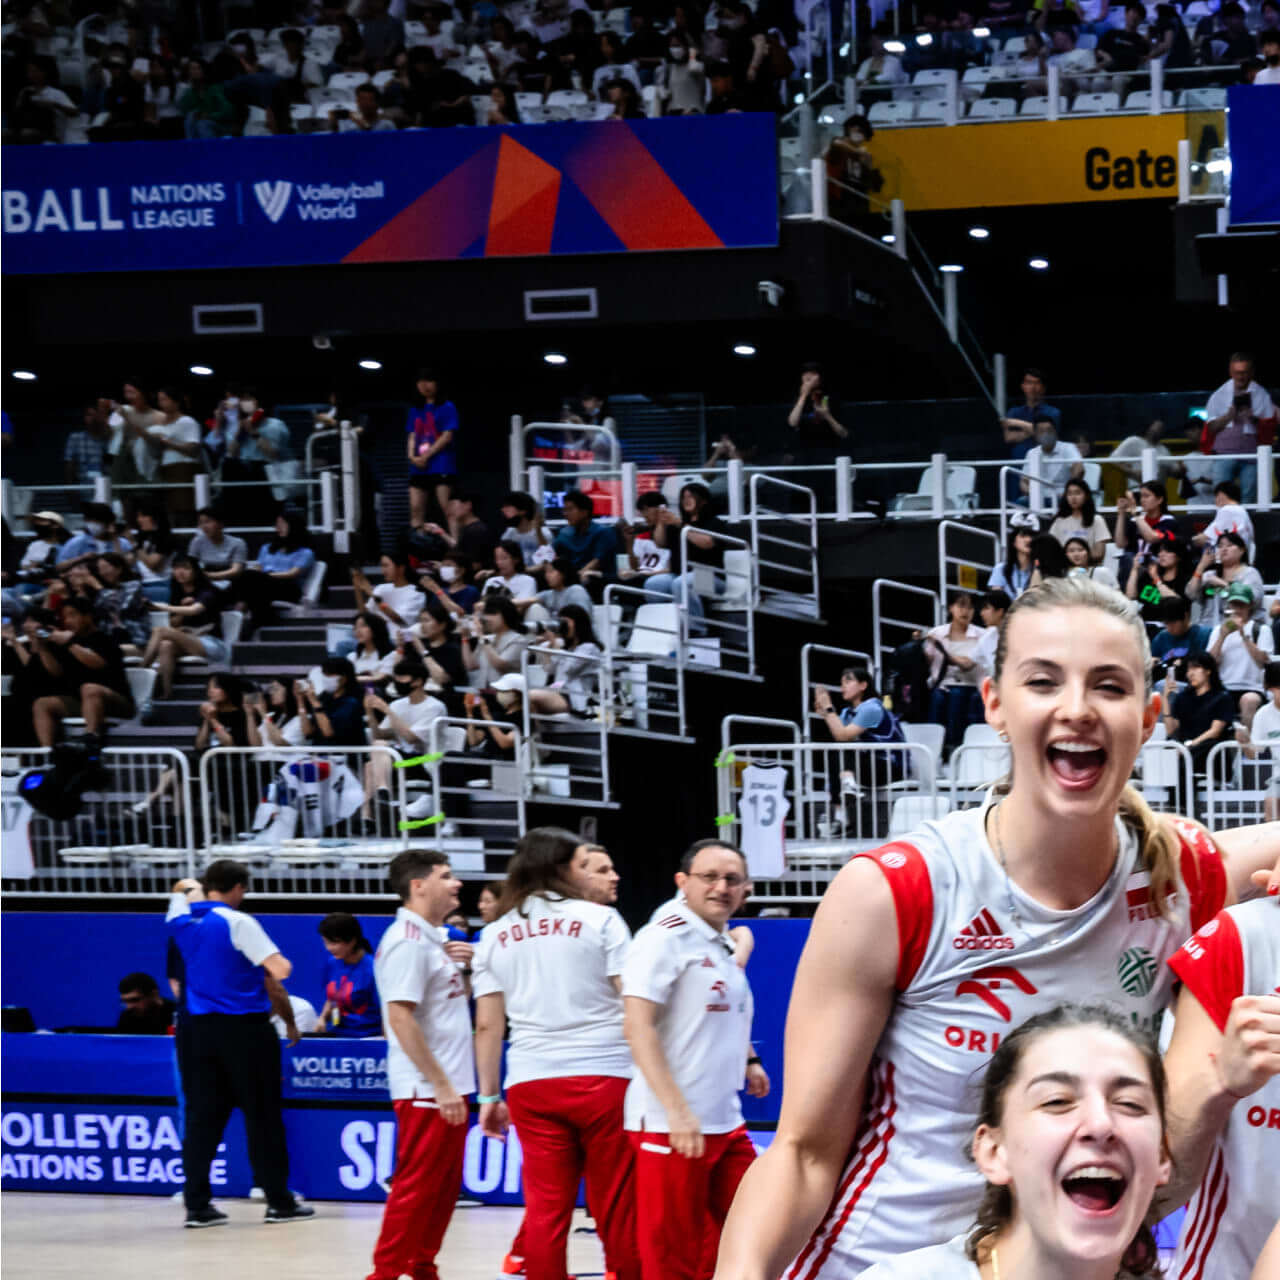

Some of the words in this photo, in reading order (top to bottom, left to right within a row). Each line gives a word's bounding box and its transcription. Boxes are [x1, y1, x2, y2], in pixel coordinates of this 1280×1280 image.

[1085, 147, 1177, 191] Gate
[130, 182, 226, 206] NATIONS
[297, 181, 385, 203] Volleyball
[2, 186, 124, 233] BALL
[132, 207, 215, 230] LEAGUE
[297, 202, 357, 221] World
[748, 793, 778, 828] 13
[497, 917, 583, 949] POLSKA
[952, 934, 1016, 951] adidas
[292, 1056, 388, 1075] VOLLEYBA
[291, 1075, 353, 1090] NATIONS
[356, 1076, 391, 1091] LEAG
[2, 1111, 182, 1152] OLLEYBA
[112, 1157, 227, 1185] LEAGE
